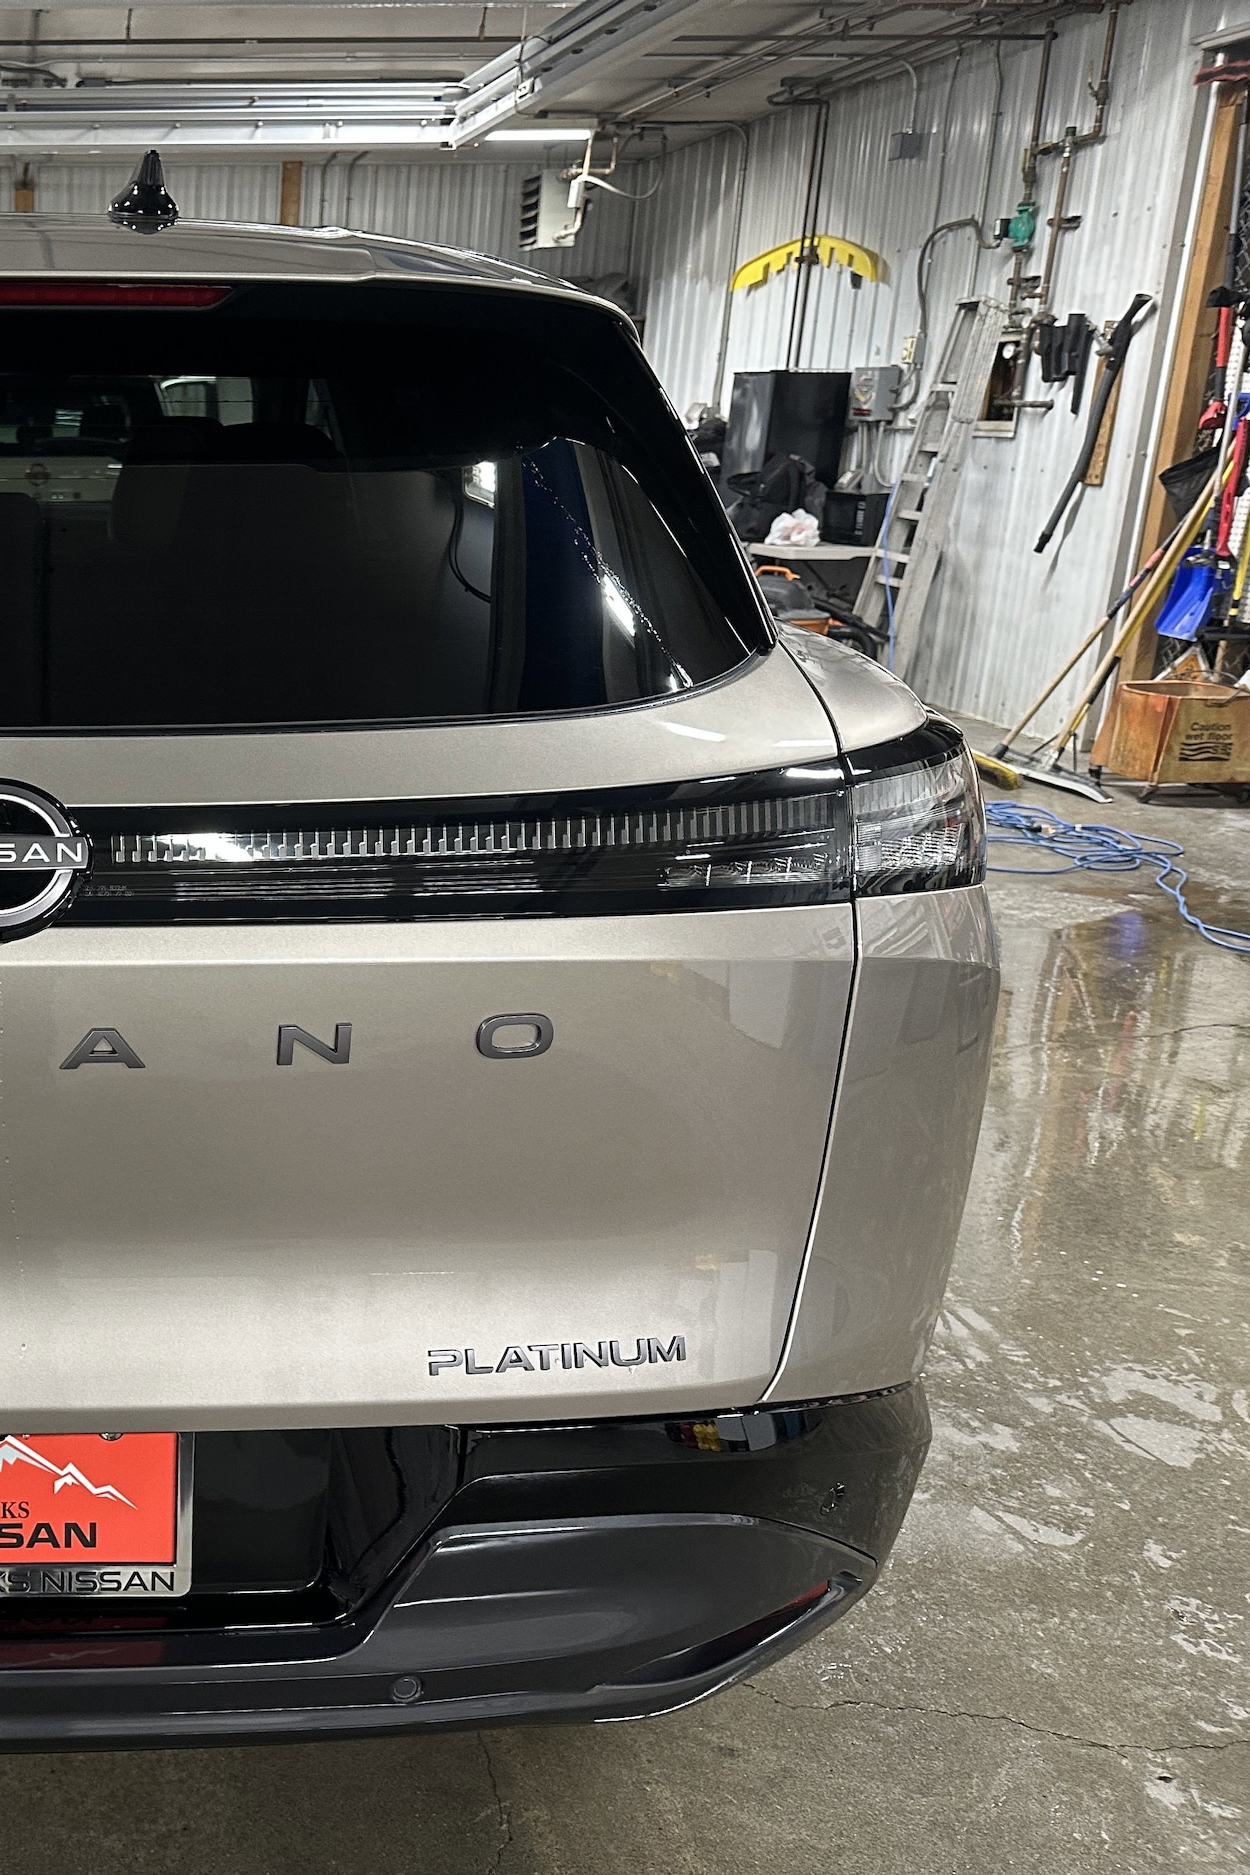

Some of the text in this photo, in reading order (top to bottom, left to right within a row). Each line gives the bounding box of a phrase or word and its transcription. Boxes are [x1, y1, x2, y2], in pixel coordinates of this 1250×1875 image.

[1190, 722, 1231, 731] Caution
[1185, 732, 1233, 740] wet floor
[427, 1335, 686, 1376] PLATINUM
[41, 1571, 175, 1592] NISSAN
